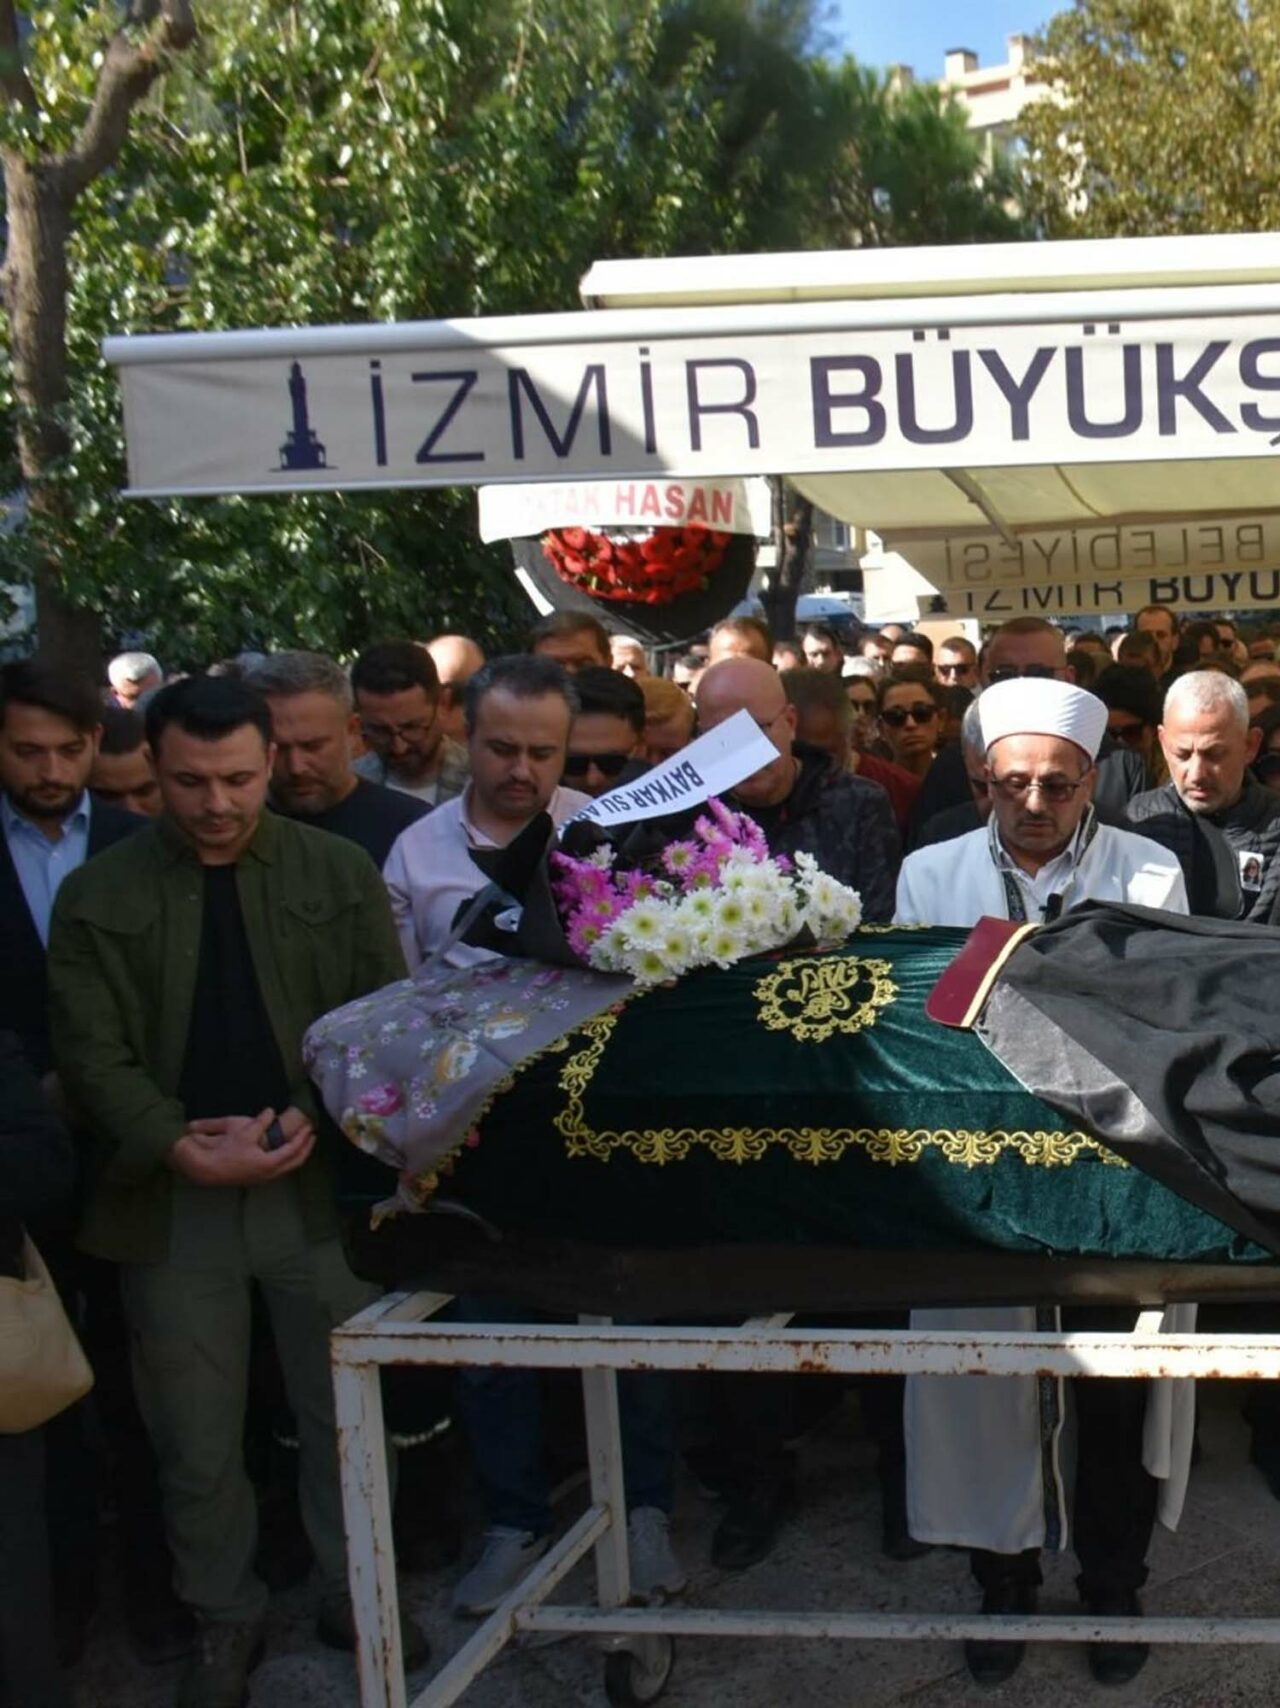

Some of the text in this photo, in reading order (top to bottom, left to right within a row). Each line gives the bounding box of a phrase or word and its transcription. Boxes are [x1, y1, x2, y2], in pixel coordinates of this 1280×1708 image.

[370, 346, 761, 467] İZMİR
[615, 484, 733, 524] HASAN
[601, 761, 705, 814] BAYKAR SU
